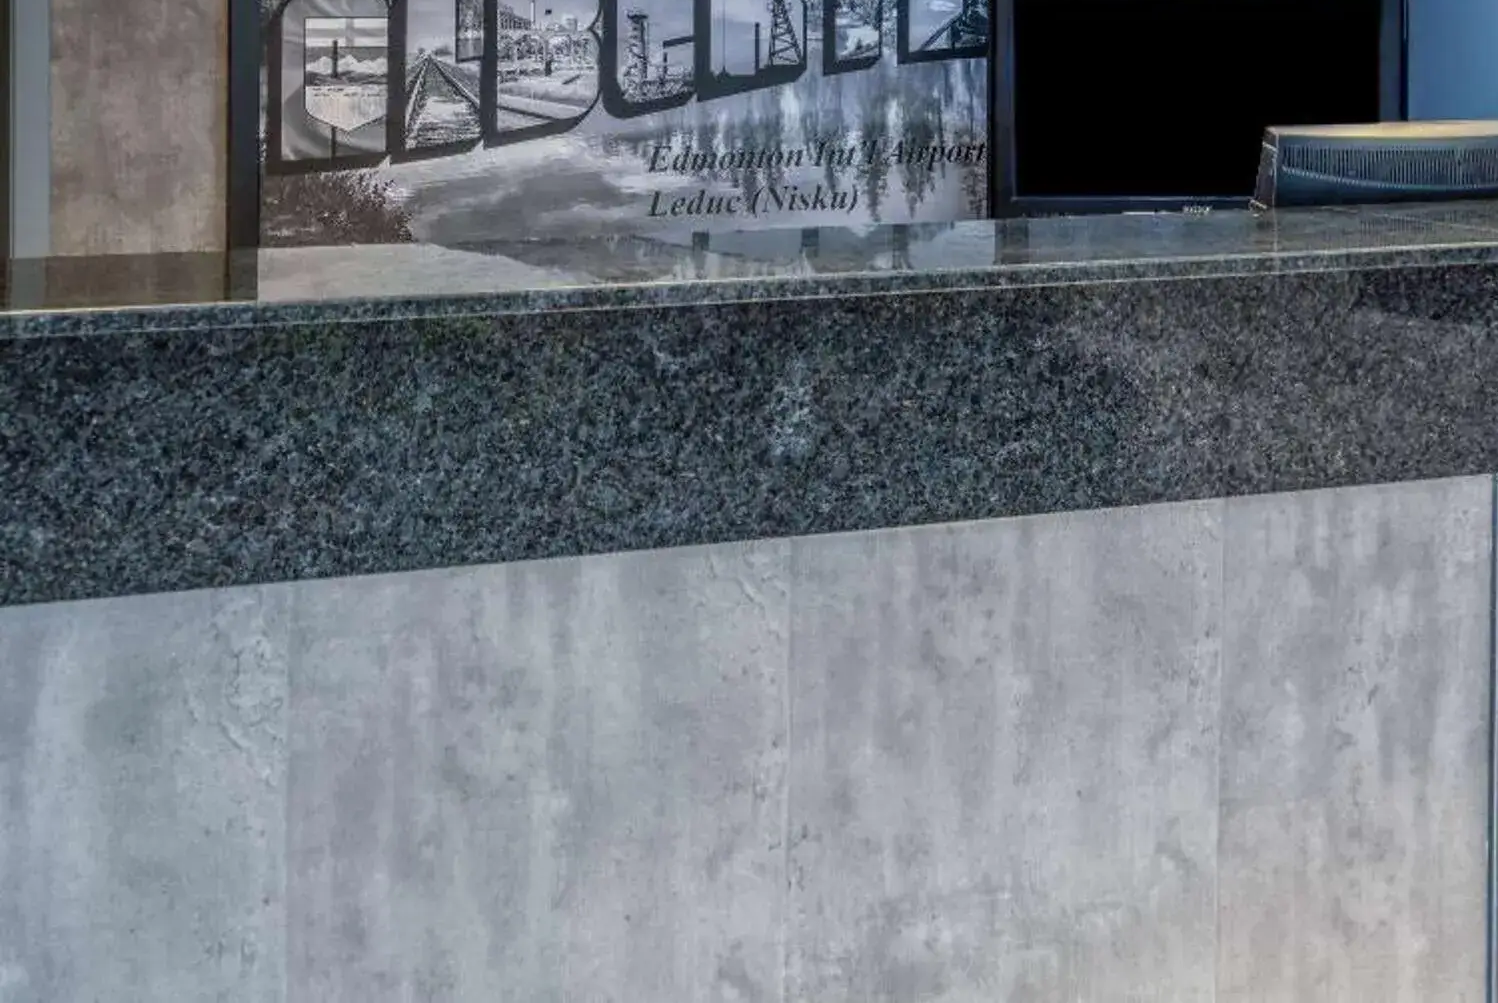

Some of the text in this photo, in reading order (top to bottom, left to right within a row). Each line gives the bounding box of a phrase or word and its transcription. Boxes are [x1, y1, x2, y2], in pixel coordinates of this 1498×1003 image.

[648, 145, 803, 174] Edmonton
[888, 139, 986, 172] Airport
[648, 183, 859, 219] Leduc (Nisku)
